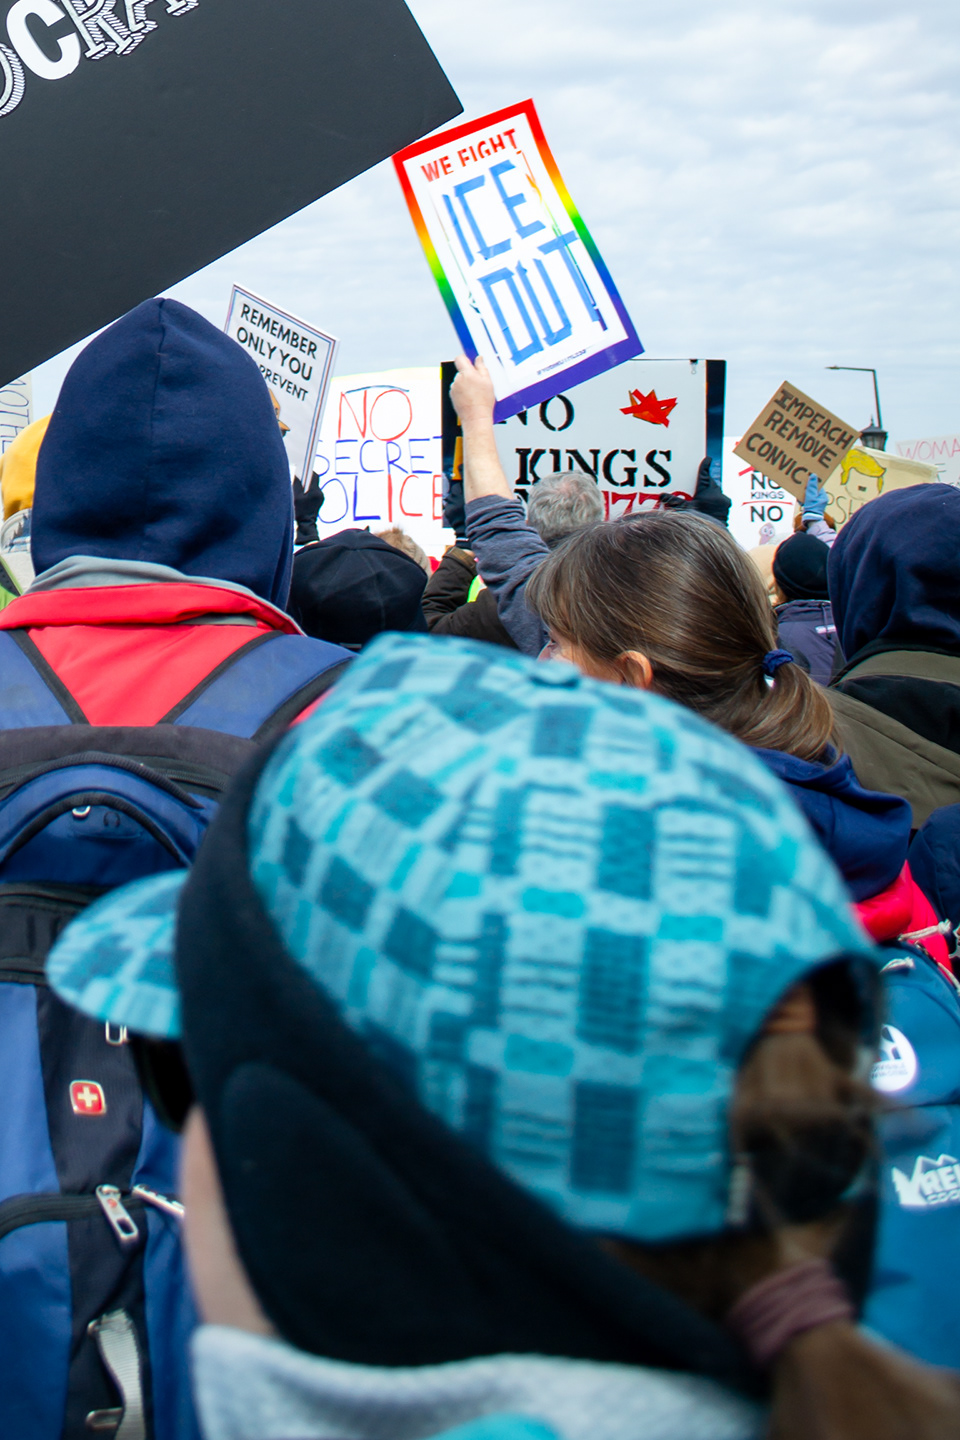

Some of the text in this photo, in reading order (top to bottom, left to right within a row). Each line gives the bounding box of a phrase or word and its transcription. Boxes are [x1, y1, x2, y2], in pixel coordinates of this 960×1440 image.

[421, 128, 518, 183] WE FIGHT
[442, 159, 546, 267] ICE
[476, 230, 600, 366] OUT
[237, 326, 314, 381] ONLY YOU
[240, 303, 318, 360] REMEMBER
[259, 363, 309, 402] PREVENT
[338, 388, 413, 442] NO
[763, 409, 838, 470] REMOVE
[773, 388, 855, 450] IMPEACH
[515, 447, 672, 487] KINGS
[746, 432, 823, 486] CONVIC
[316, 474, 442, 523] OLICE
[751, 491, 785, 499] KINGS
[751, 505, 784, 522] NO
